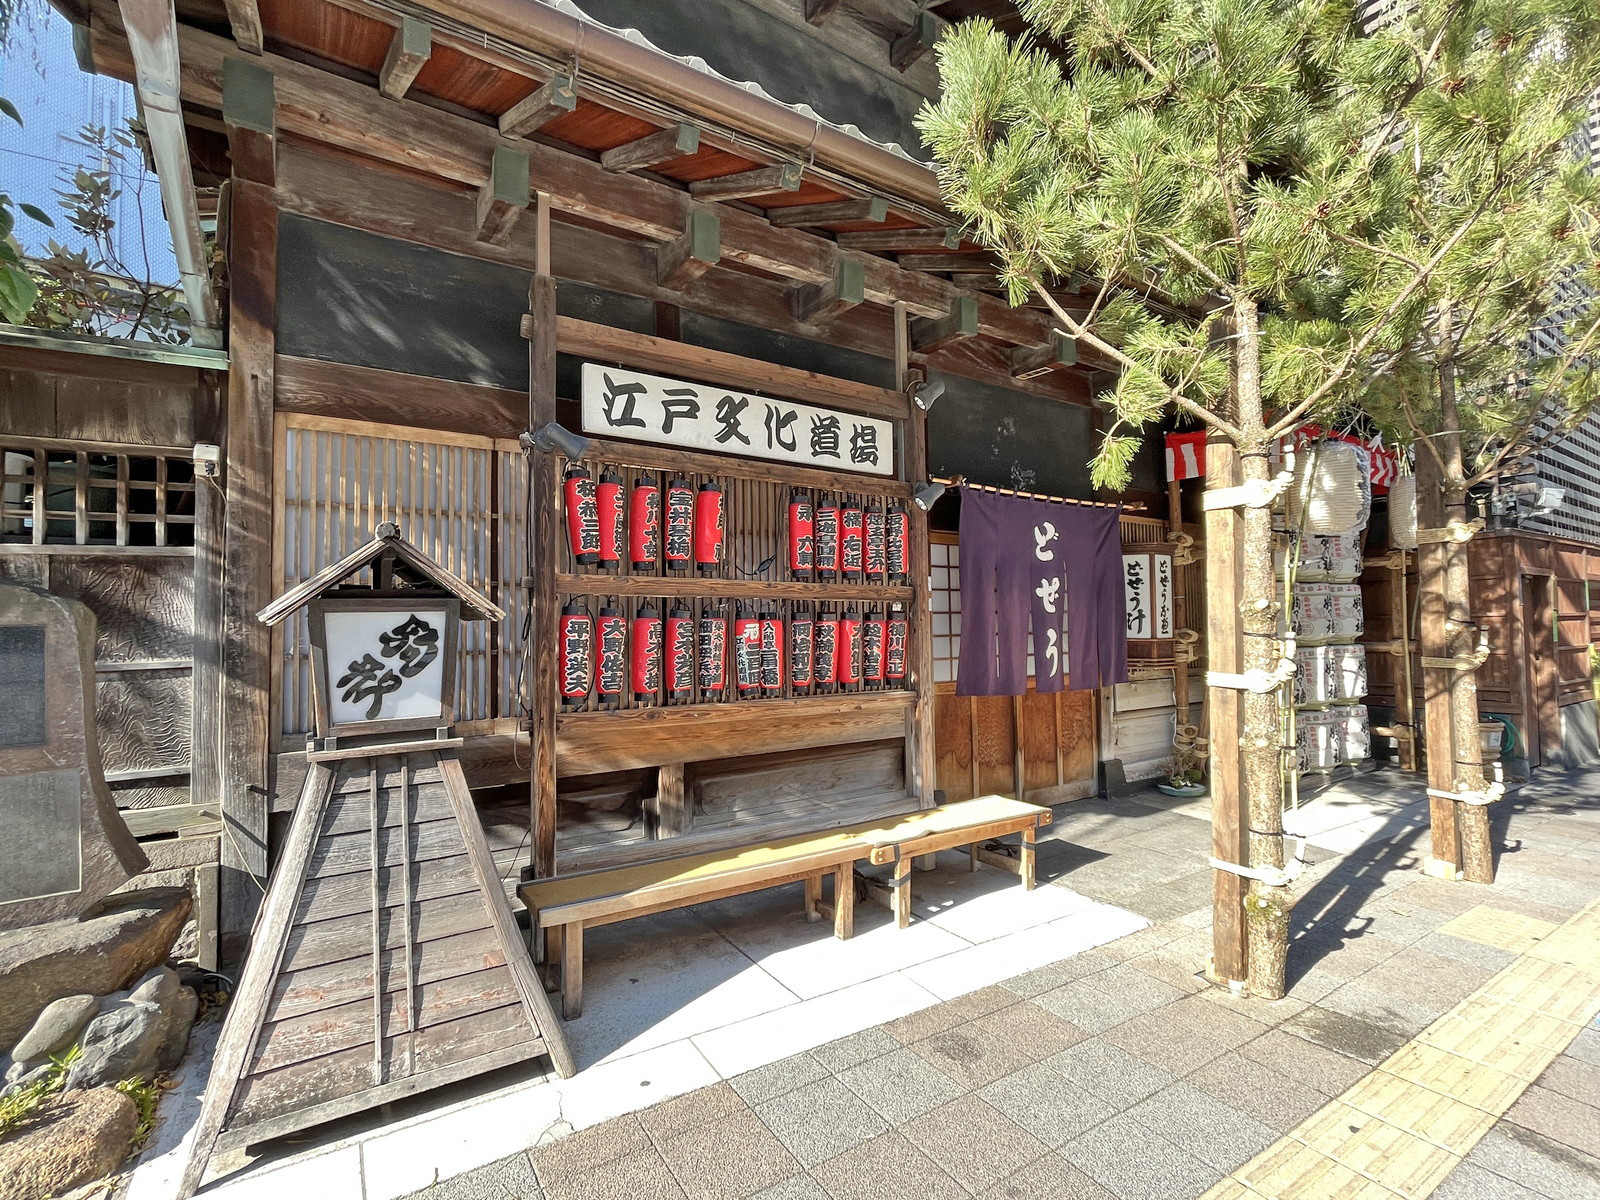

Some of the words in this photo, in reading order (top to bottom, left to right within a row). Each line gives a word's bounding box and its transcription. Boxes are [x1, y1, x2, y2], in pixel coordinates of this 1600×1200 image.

[602, 372, 880, 466] 江戸文化道場
[1034, 521, 1060, 678] どぜう
[1127, 560, 1146, 635] どぜう汁
